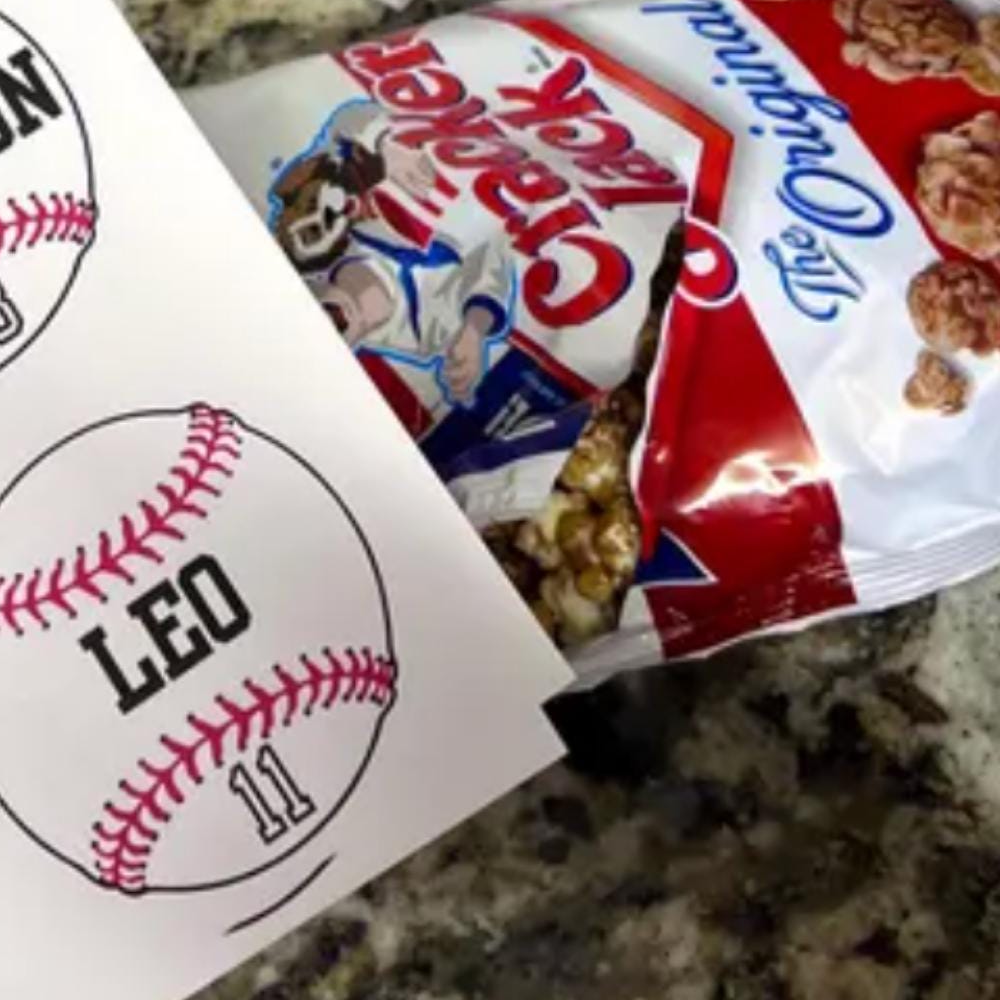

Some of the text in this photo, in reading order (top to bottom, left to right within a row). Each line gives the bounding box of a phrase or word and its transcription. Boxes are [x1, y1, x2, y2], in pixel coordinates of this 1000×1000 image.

[344, 39, 634, 330] Cracker
[762, 224, 868, 322] The
[78, 553, 252, 716] LEO
[228, 743, 317, 846] 11
